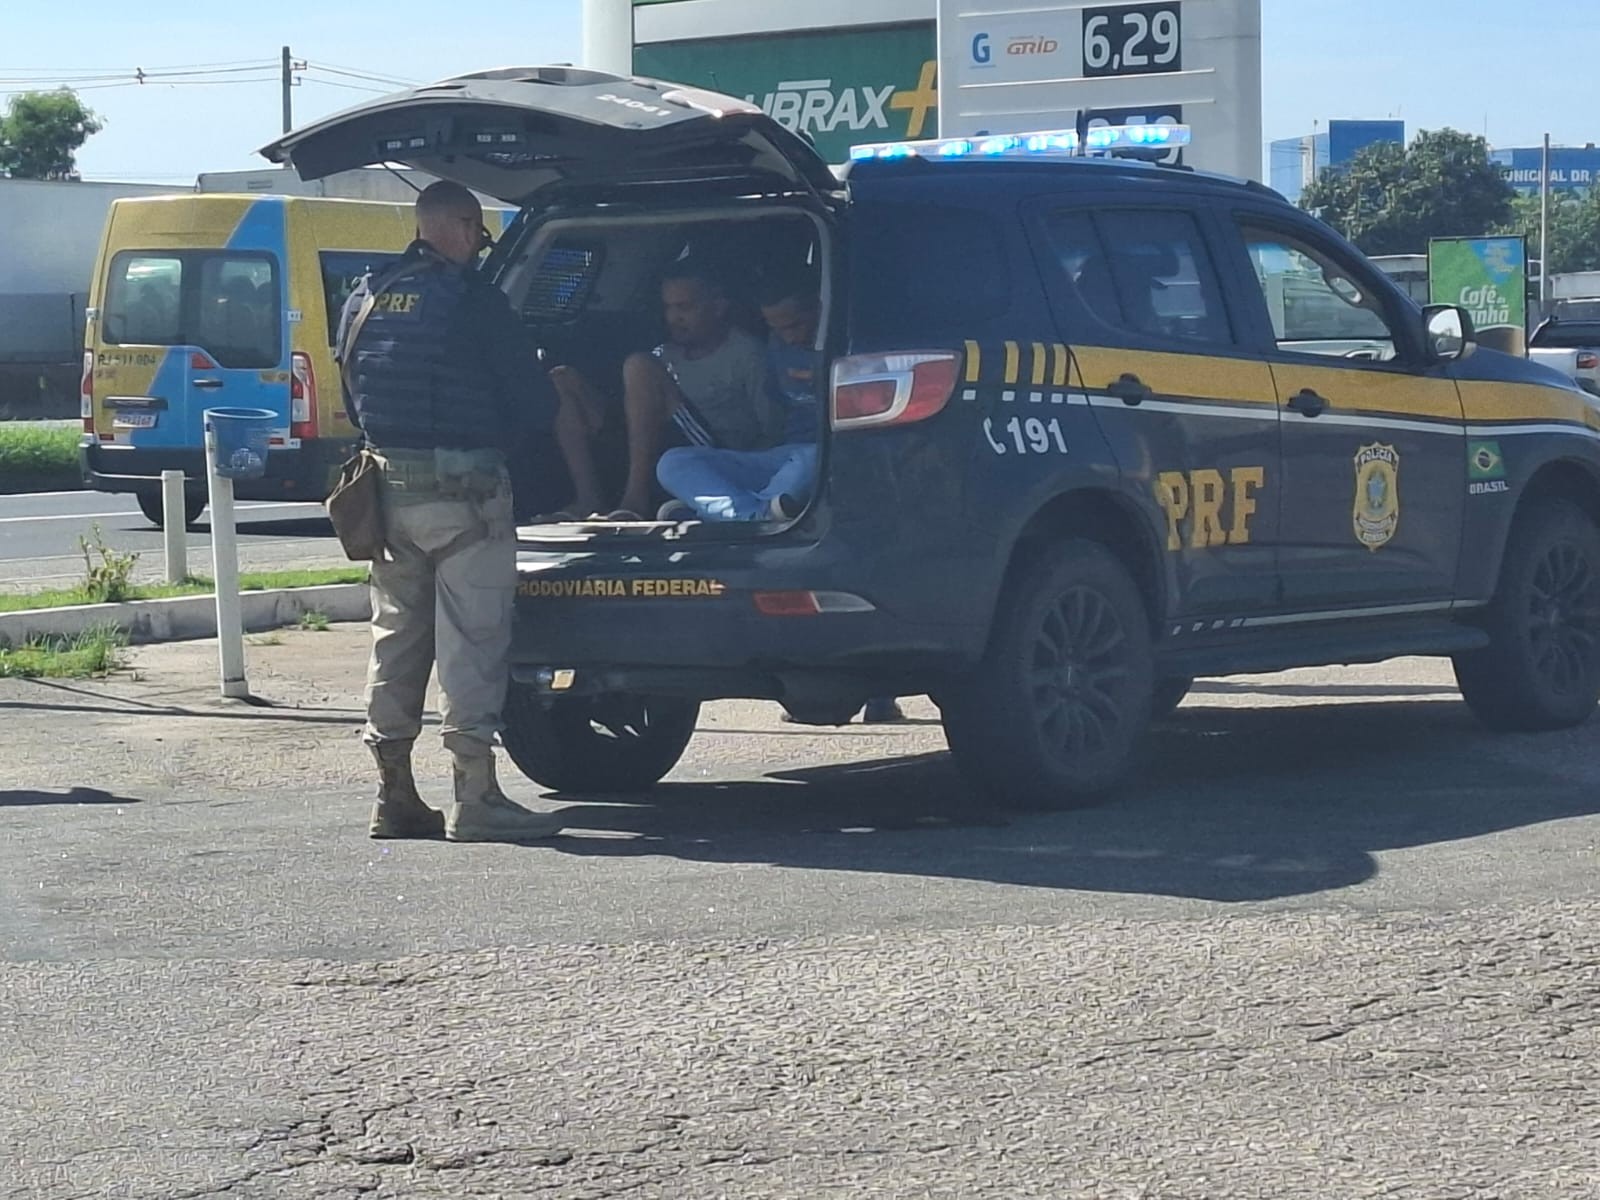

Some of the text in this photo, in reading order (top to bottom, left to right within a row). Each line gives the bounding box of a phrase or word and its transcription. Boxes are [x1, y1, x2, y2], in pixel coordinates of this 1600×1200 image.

[1084, 11, 1178, 70] 6,29
[373, 293, 421, 313] PRF
[1460, 284, 1497, 309] Café
[1007, 417, 1068, 454] 191
[1154, 466, 1264, 551] PRF
[632, 579, 724, 596] FEDERAL
